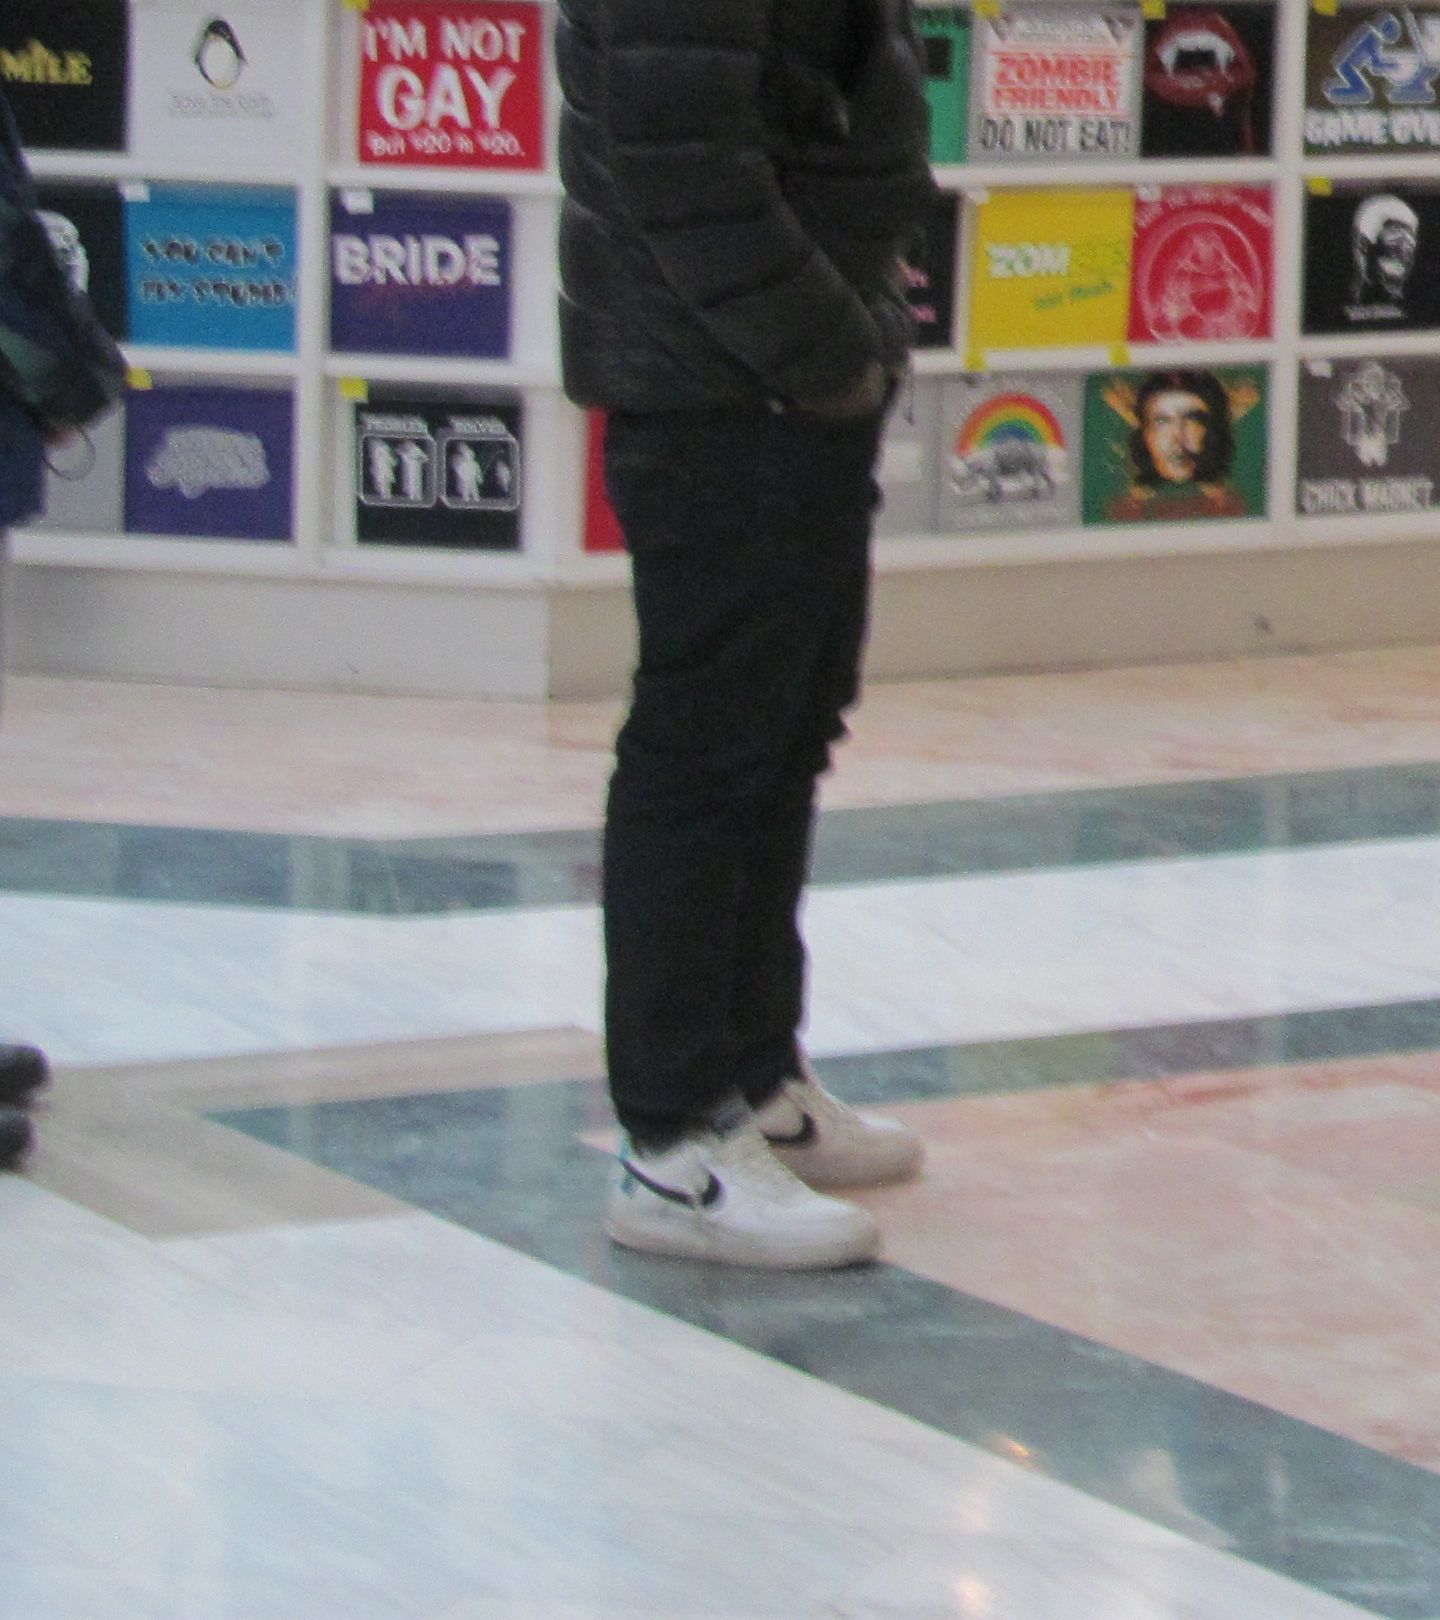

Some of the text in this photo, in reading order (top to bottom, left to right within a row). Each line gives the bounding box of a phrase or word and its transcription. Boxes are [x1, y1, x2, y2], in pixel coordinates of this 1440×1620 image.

[361, 16, 527, 64] I'M NOT
[995, 54, 1124, 87] ZOMBIE
[374, 61, 518, 131] GAY
[991, 86, 1122, 114] FRIENDLY
[977, 116, 1015, 153] DO
[1021, 117, 1069, 153] NOT
[1303, 106, 1388, 147] GAME
[331, 233, 502, 287] BRIDE
[1359, 476, 1437, 515] MAGNET
